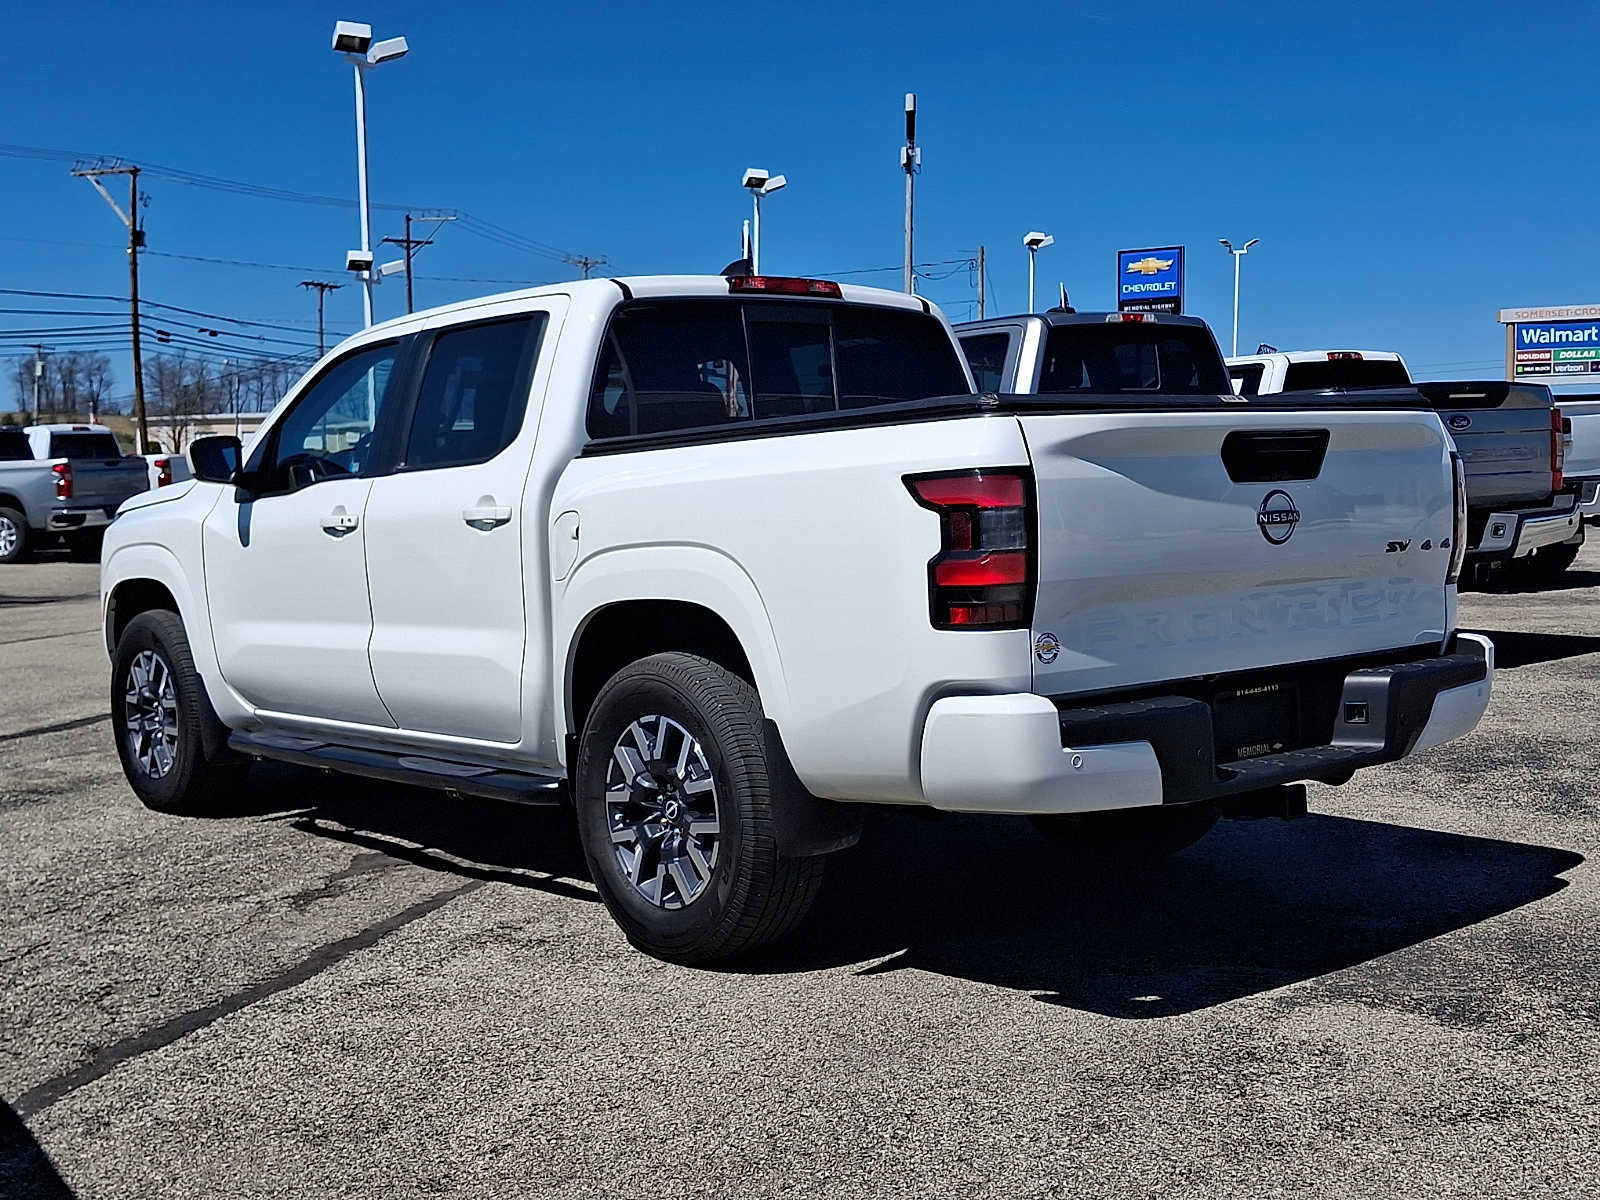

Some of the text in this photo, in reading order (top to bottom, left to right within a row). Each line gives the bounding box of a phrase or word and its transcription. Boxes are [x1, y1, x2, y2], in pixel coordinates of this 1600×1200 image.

[1122, 281, 1176, 293] CHEVROLET
[1521, 325, 1598, 344] Walmart
[1559, 350, 1596, 358] DOLLAR
[1554, 364, 1584, 372] verizon
[1259, 512, 1299, 523] NISSAN
[1385, 539, 1411, 553] SV
[1237, 743, 1271, 758] MEMORIAL
